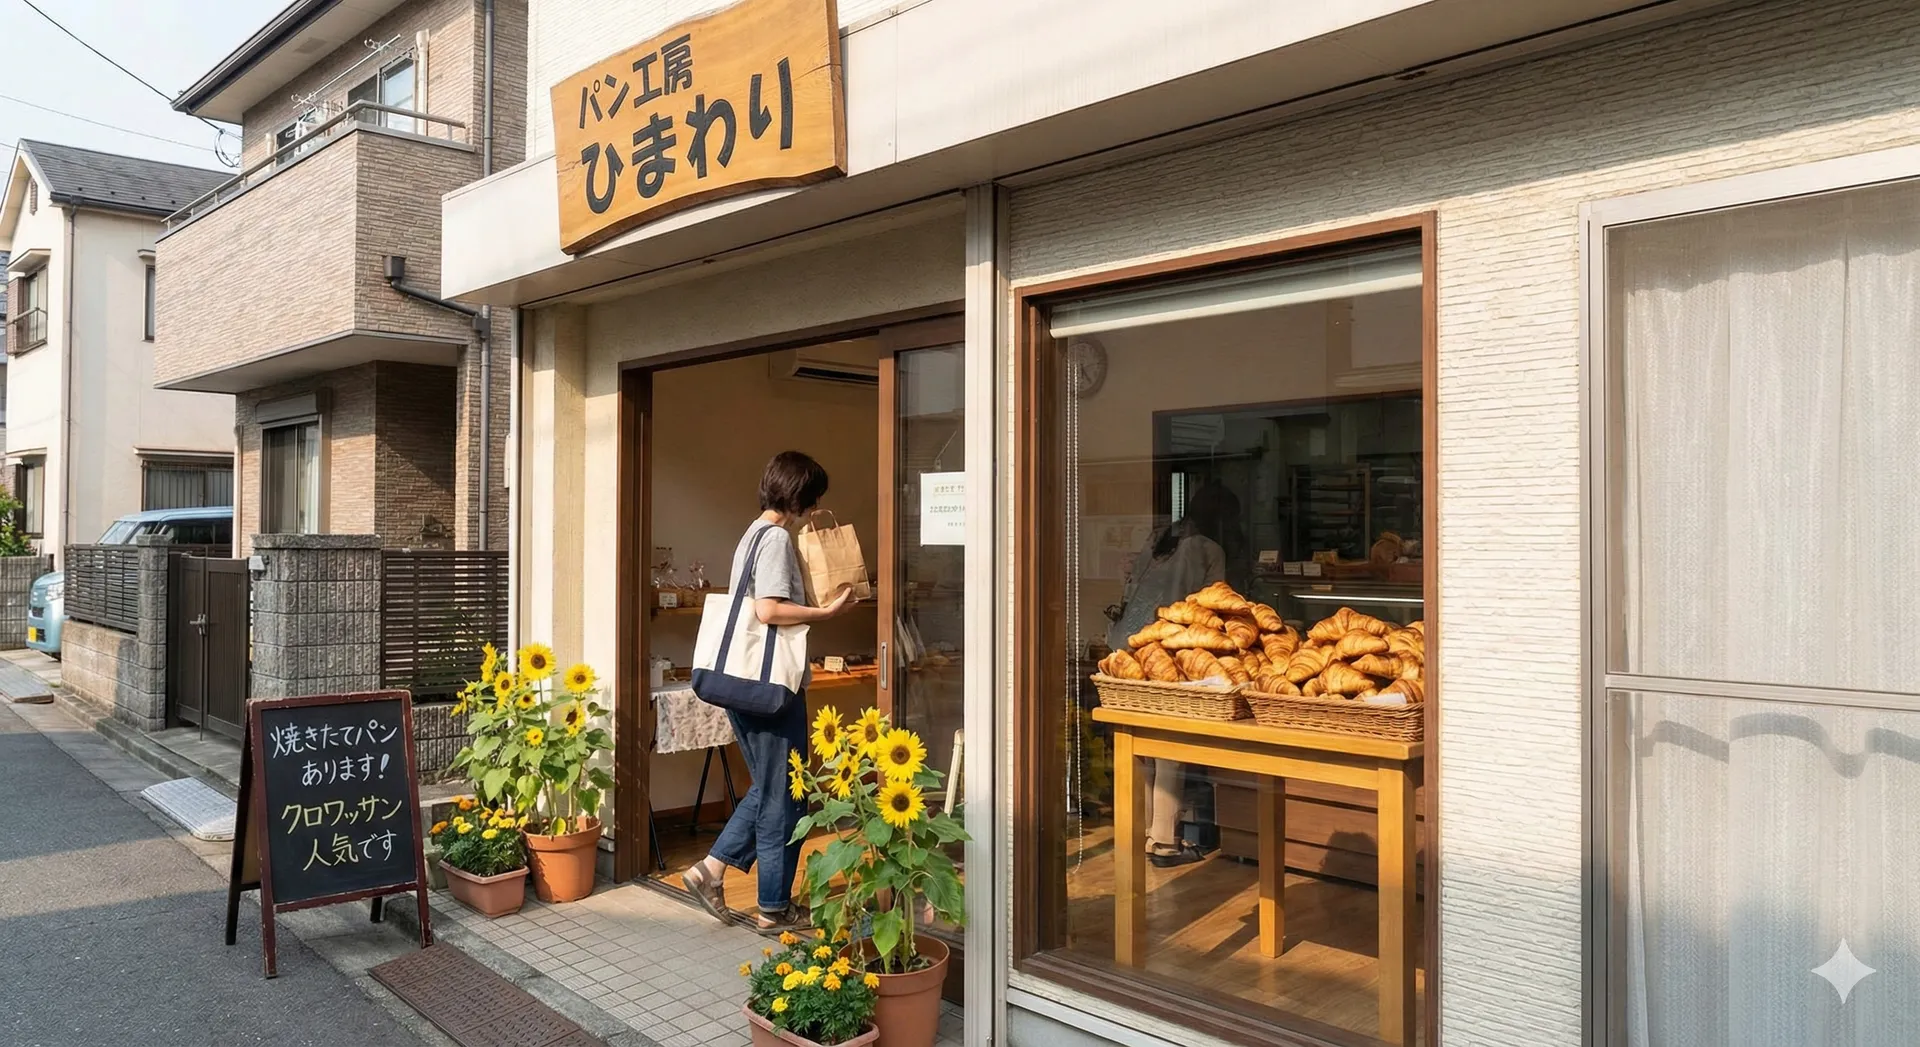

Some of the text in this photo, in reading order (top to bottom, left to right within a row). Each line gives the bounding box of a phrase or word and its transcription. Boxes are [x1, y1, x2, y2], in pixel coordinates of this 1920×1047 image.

[579, 33, 693, 130] パン工房
[581, 56, 794, 214] ひまわり
[270, 718, 398, 758] 焼きたてパン
[281, 795, 402, 834] クロワッサン
[303, 829, 397, 871] 人気です
